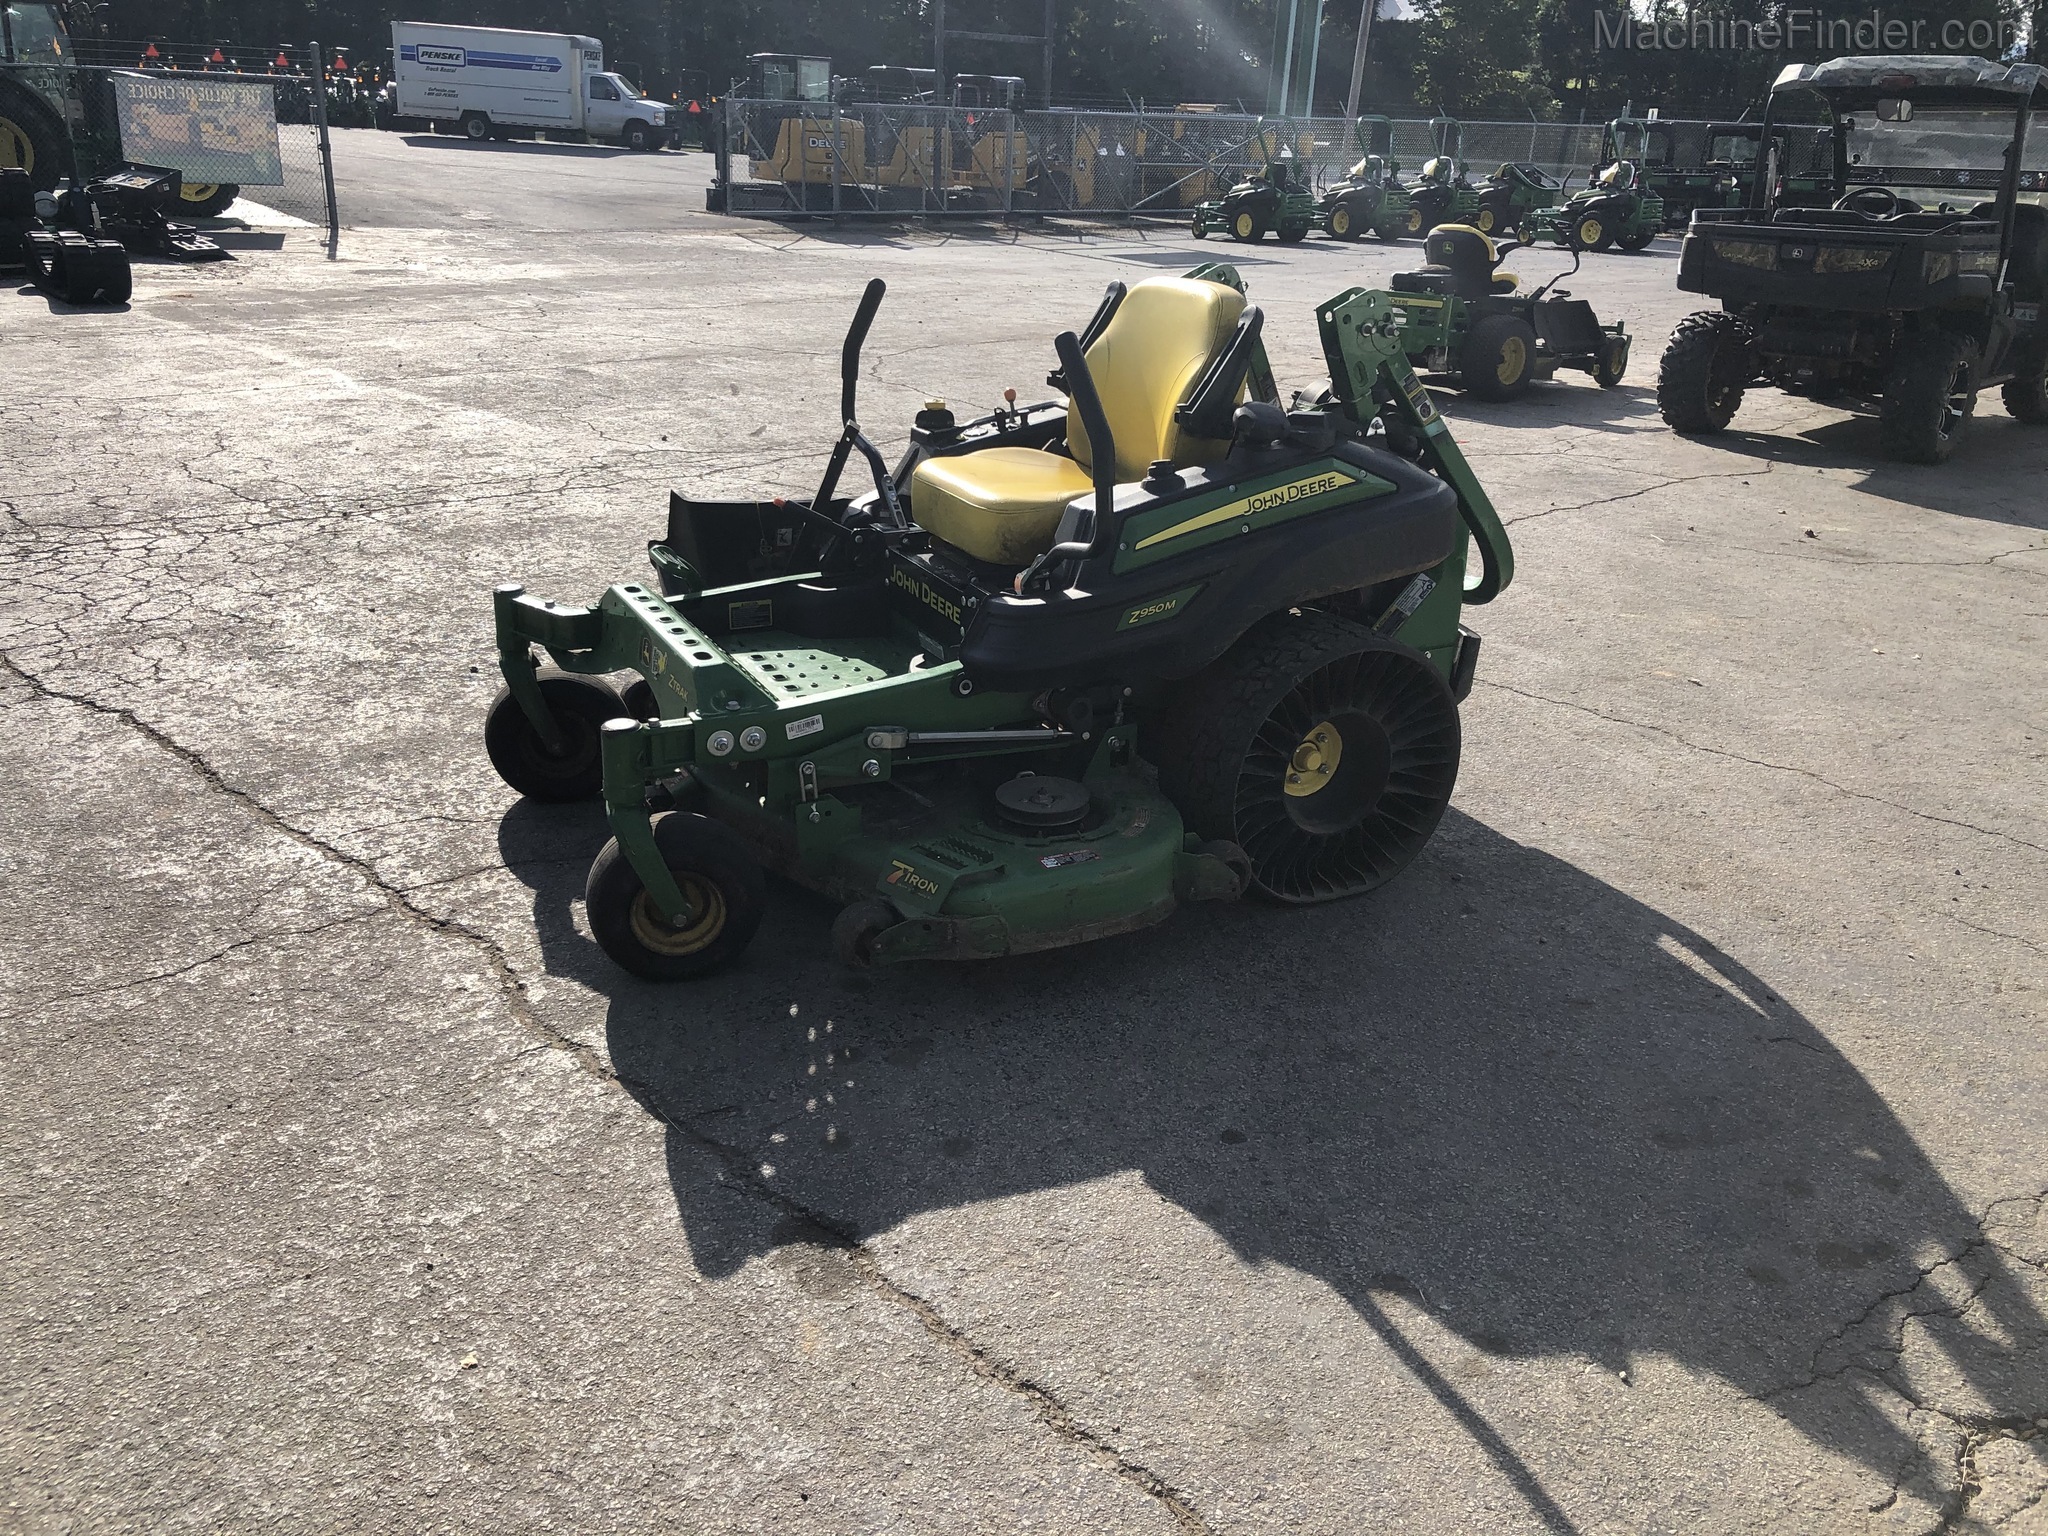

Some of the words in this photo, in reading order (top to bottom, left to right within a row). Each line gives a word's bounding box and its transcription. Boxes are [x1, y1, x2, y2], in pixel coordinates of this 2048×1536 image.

[421, 51, 462, 60] PENSKE
[809, 137, 846, 149] DEEE
[1243, 494, 1285, 515] JOHN
[1287, 476, 1337, 501] DEERE
[890, 564, 920, 598] JOHN
[921, 582, 961, 625] DEERE
[1128, 599, 1177, 624] Z950M
[668, 674, 689, 703] ZTRAK
